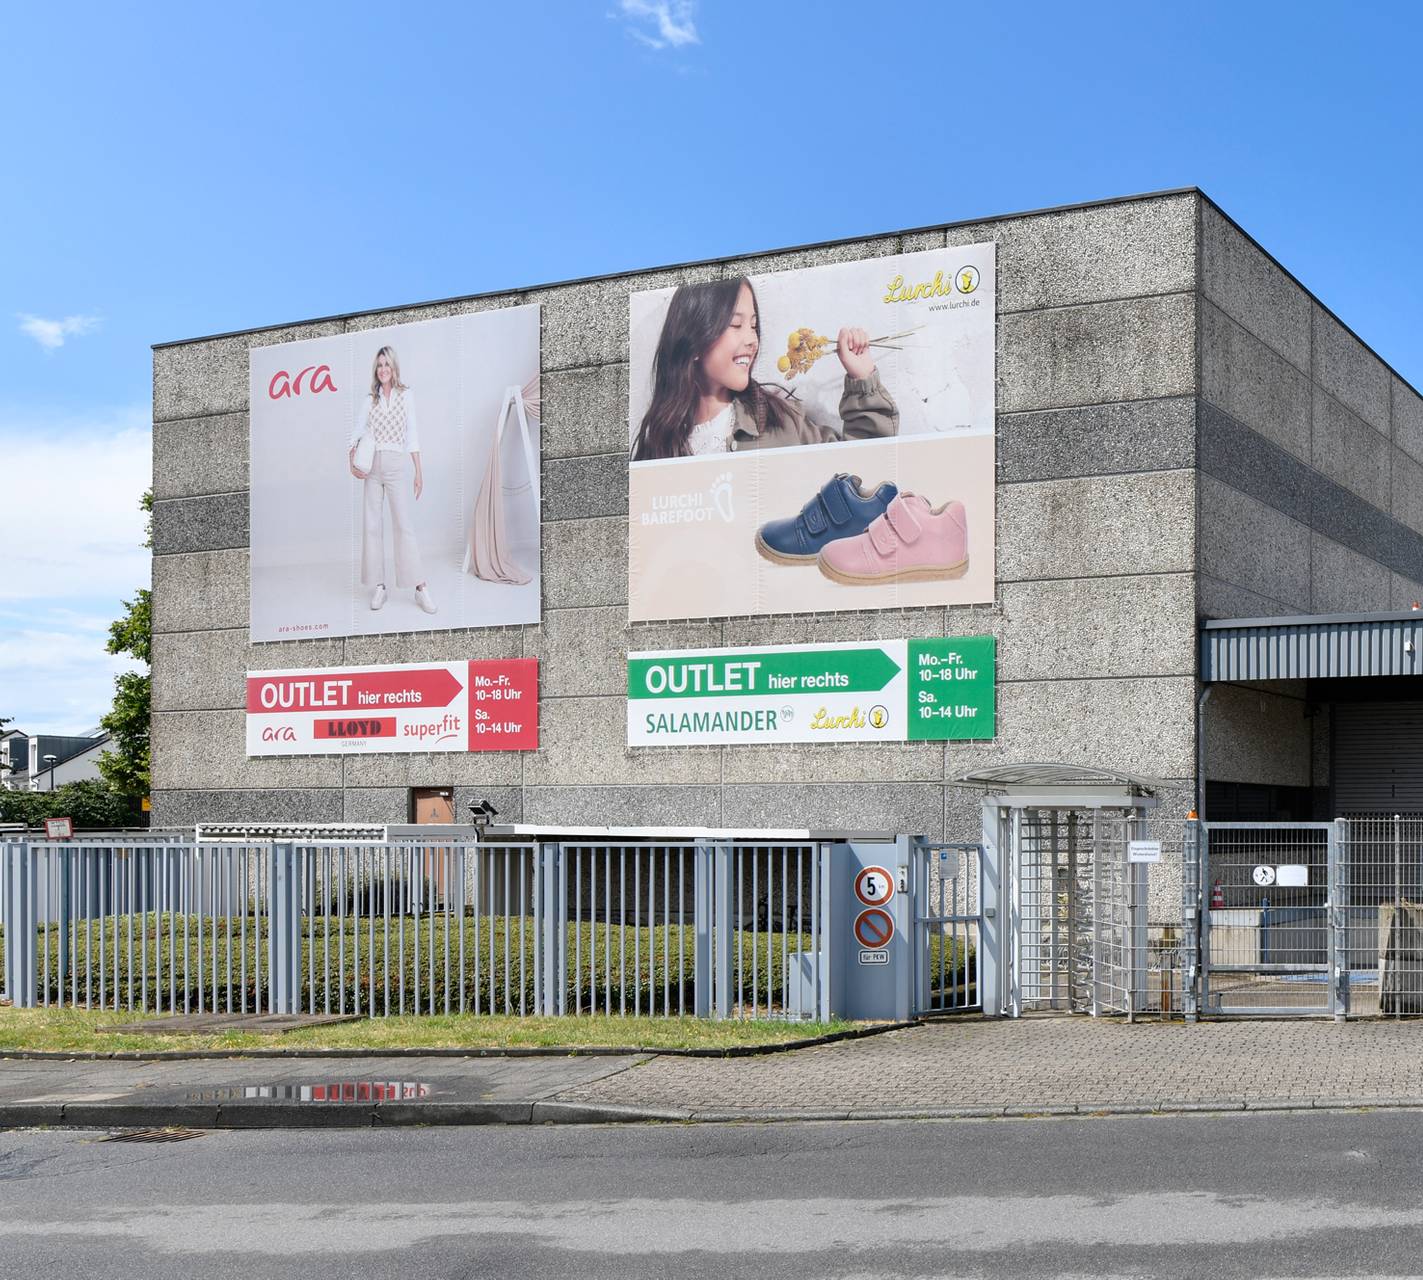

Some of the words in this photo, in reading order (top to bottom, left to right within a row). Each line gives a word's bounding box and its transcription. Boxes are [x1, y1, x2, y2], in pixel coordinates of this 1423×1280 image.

[882, 271, 952, 303] Lurchi
[928, 300, 981, 312] www.lurchi.de
[268, 364, 338, 400] ara
[652, 493, 703, 508] LURCHI
[641, 507, 713, 525] BAREFOOT
[278, 623, 329, 633] ara-shoes.com
[645, 662, 761, 694] OUTLET
[768, 673, 797, 689] hier
[801, 672, 849, 688] rechts
[954, 667, 978, 681] Uhr
[260, 680, 352, 708] OUTLET
[358, 690, 380, 704] hier
[384, 689, 422, 703] rechts
[504, 688, 522, 700] Uhr
[918, 691, 938, 704] Sa.
[475, 709, 490, 720] Sa.
[809, 705, 867, 730] Lurchi
[954, 705, 978, 719] Uhr
[328, 720, 382, 737] LLOYD
[404, 715, 461, 740] superfit
[504, 722, 522, 733] Uhr
[646, 710, 777, 734] SALAMANDER
[262, 726, 297, 742] ara
[867, 877, 876, 896] 5
